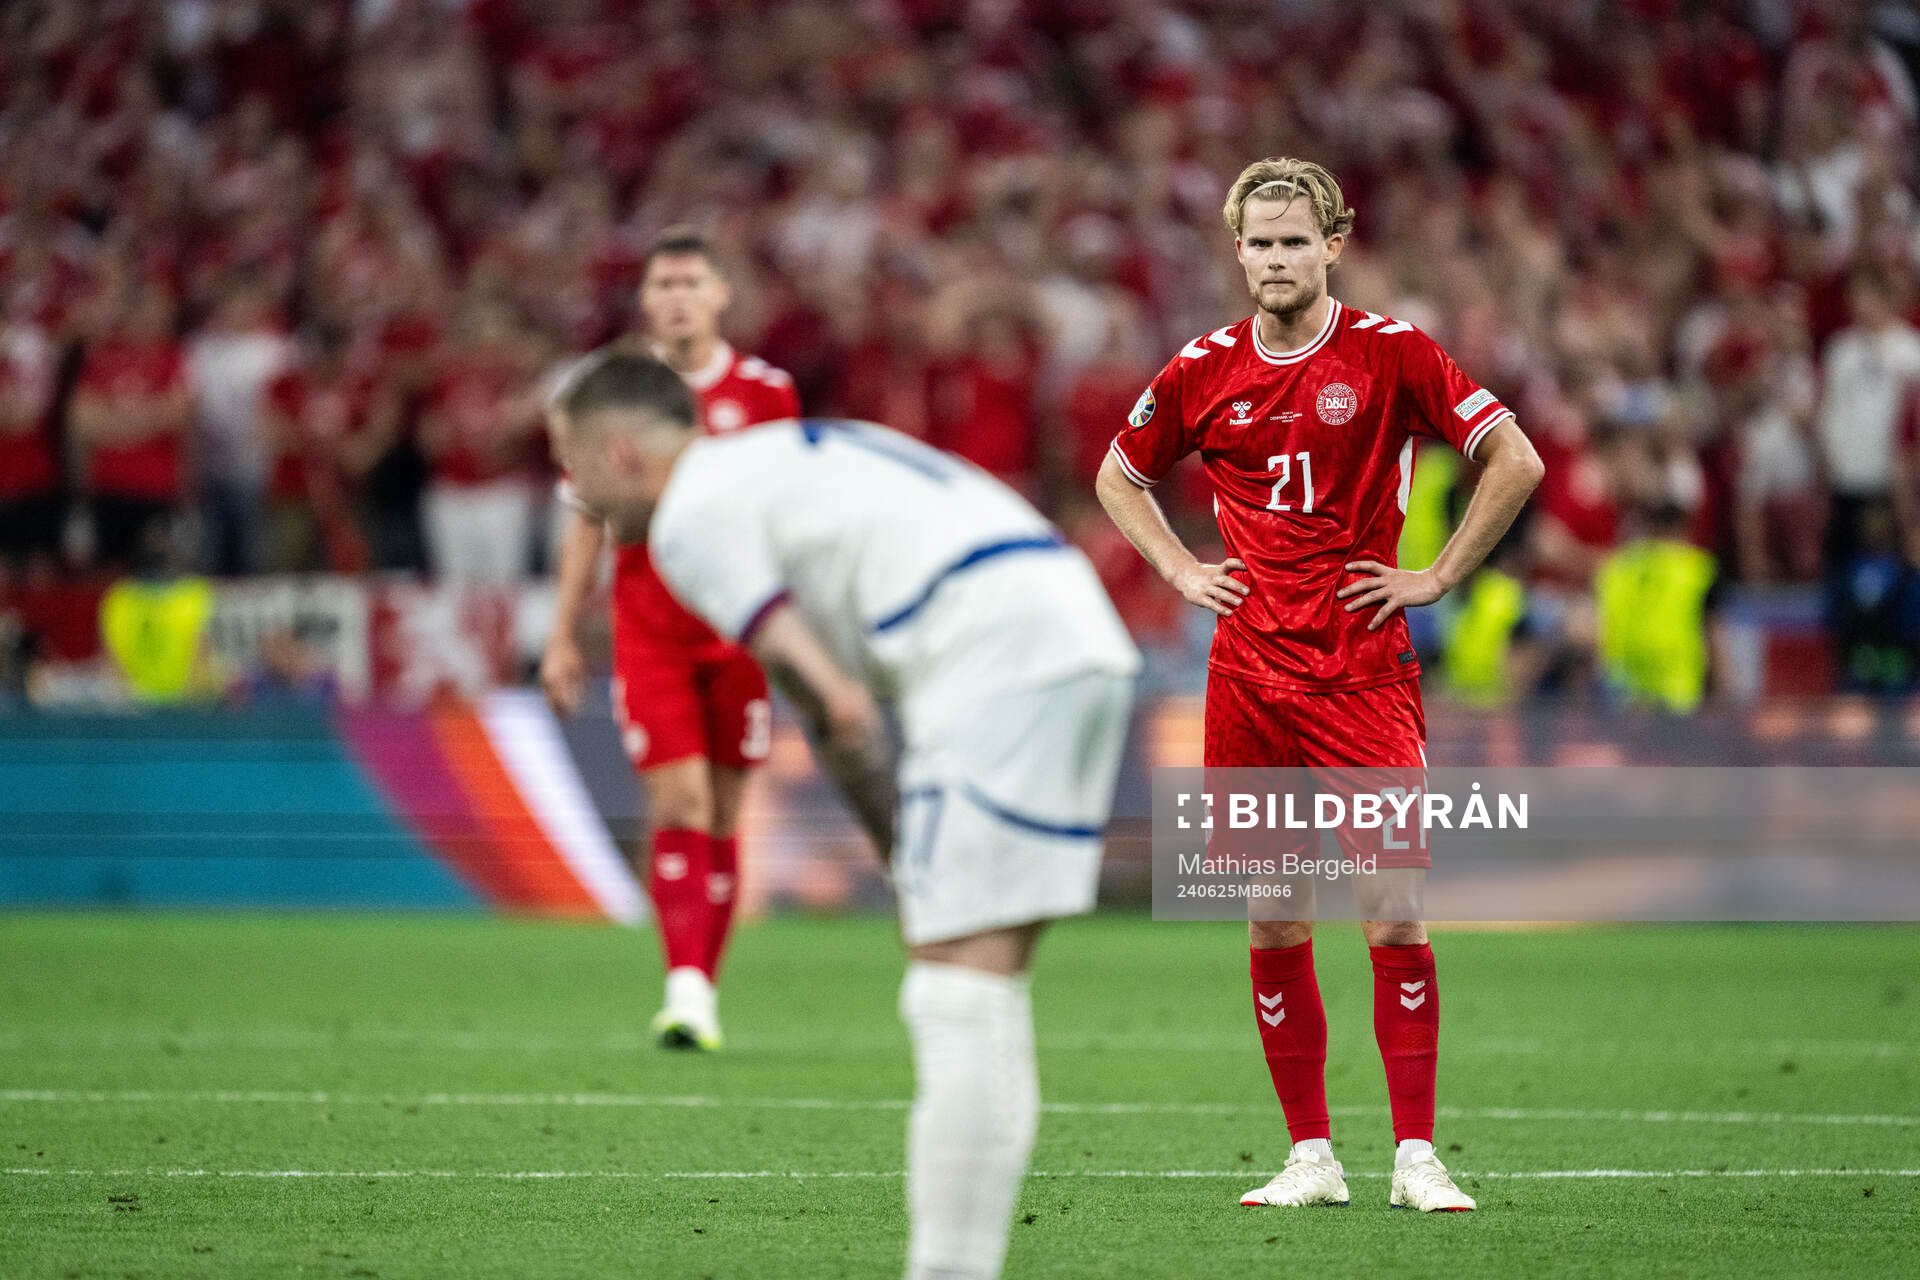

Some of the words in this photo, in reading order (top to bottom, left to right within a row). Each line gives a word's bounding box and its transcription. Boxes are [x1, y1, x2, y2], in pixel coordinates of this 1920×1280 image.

[1325, 396, 1348, 410] DBU
[1459, 392, 1493, 416] FOUNDAT
[1265, 451, 1315, 513] 21
[1379, 786, 1428, 850] 21
